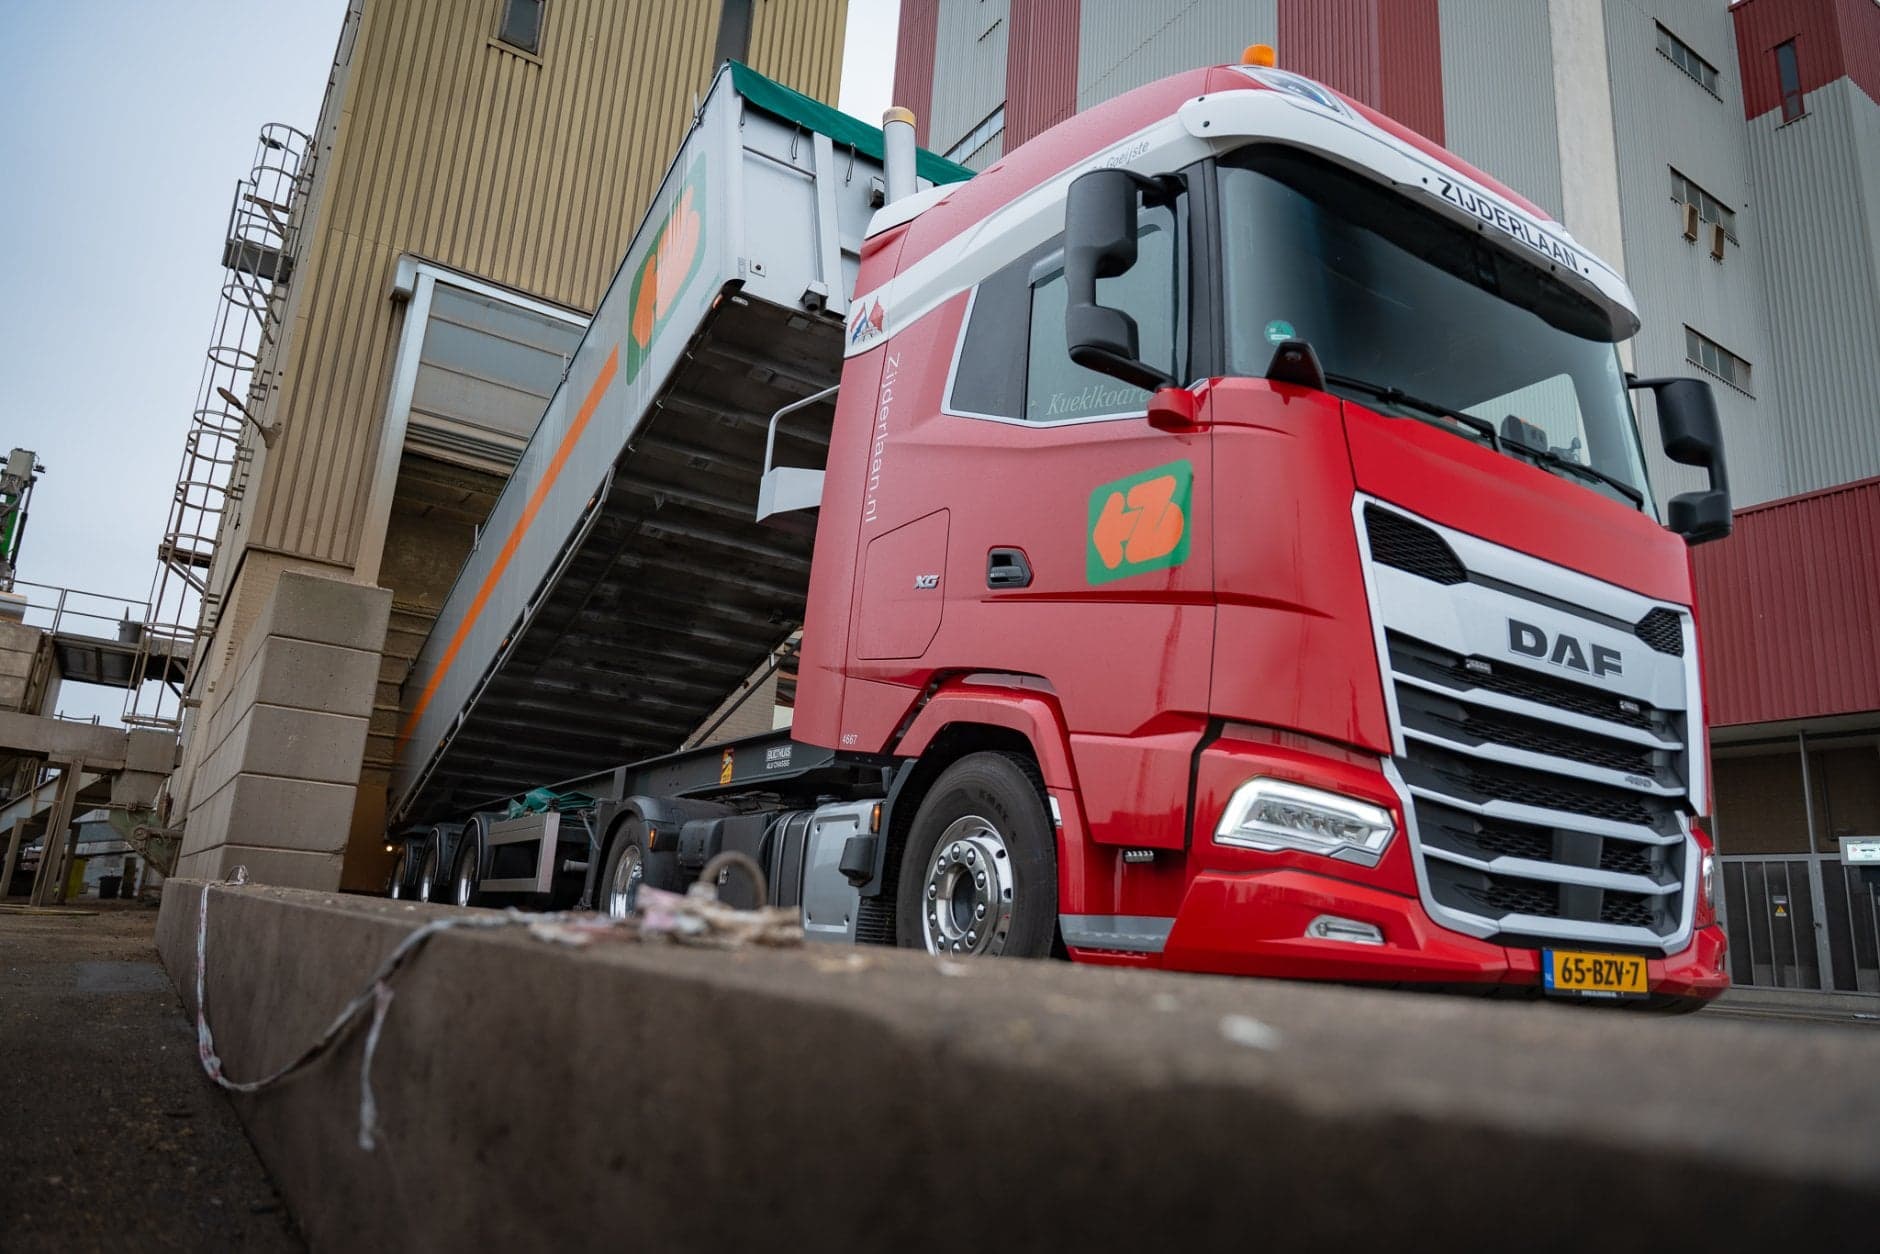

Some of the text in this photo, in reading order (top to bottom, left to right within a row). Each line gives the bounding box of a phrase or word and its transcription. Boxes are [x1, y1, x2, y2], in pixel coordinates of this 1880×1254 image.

[1438, 177, 1578, 271] ZIJDERLAAN
[865, 352, 900, 522] Zijderlaan.nl
[914, 575, 940, 589] XG
[1507, 617, 1623, 677] DAF
[1562, 956, 1640, 987] 65-BZV-7
